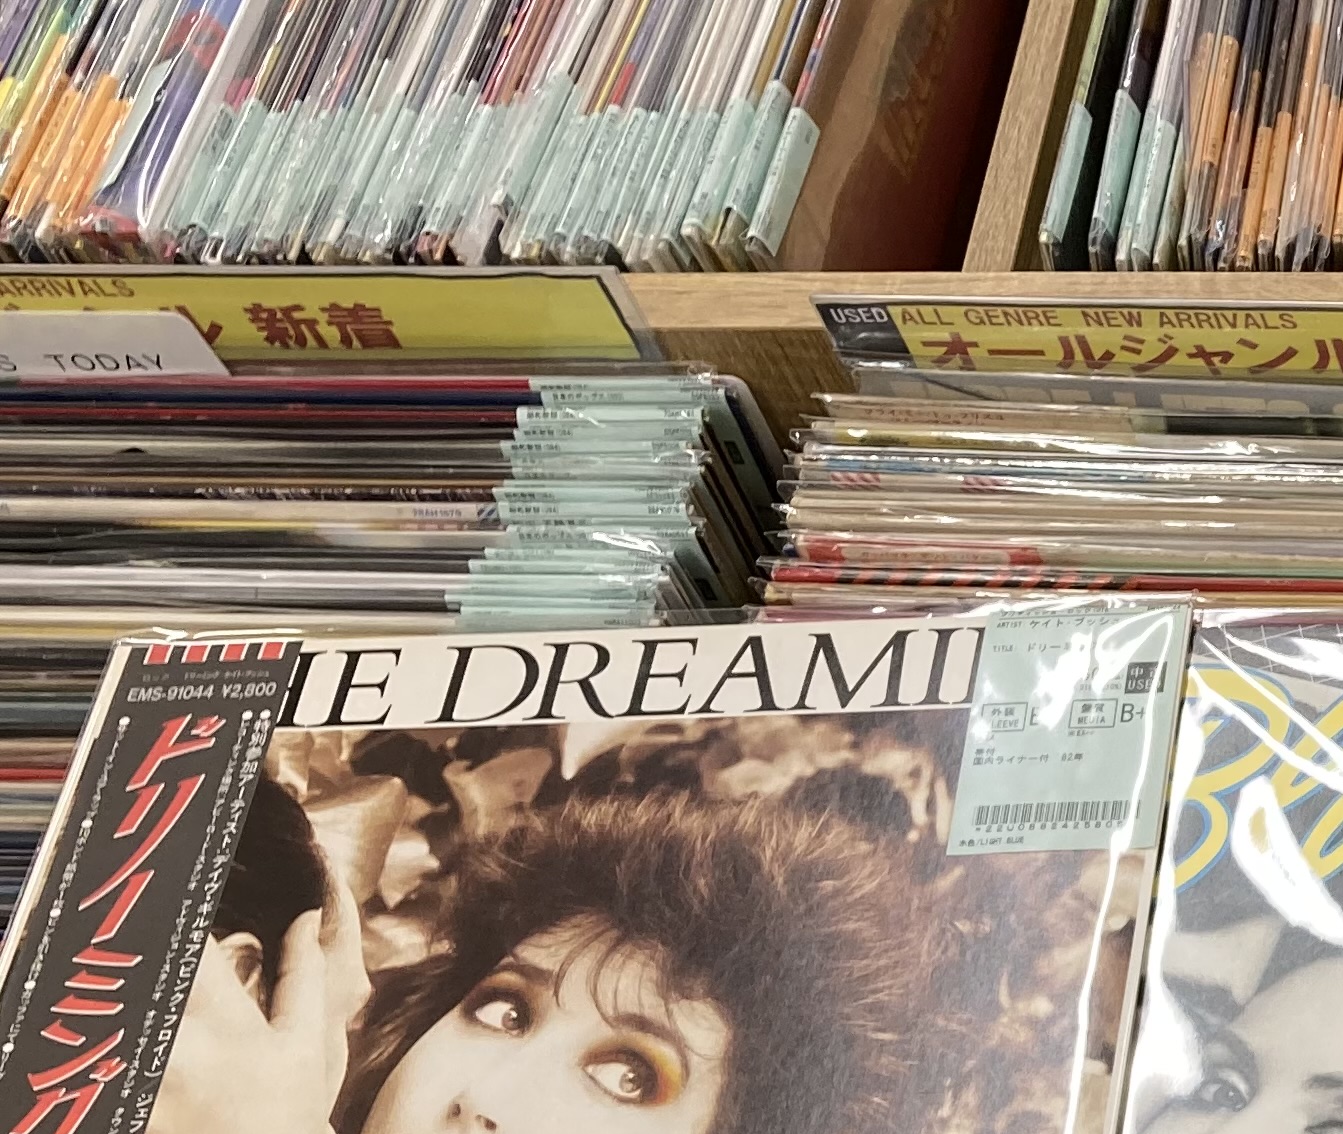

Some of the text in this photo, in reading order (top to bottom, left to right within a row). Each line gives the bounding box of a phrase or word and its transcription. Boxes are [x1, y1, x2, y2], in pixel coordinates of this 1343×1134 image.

[0, 278, 135, 298] ARRIVALS
[243, 302, 403, 350] 新着
[830, 307, 1298, 330] USED ALL GENRE NEW ARRIVALS
[43, 353, 163, 372] TODAY
[127, 681, 278, 703] EMS-91044 ¥2,800
[1077, 715, 1107, 726] MEDIA
[1121, 702, 1147, 724] B+
[990, 718, 1020, 730] LEEVE
